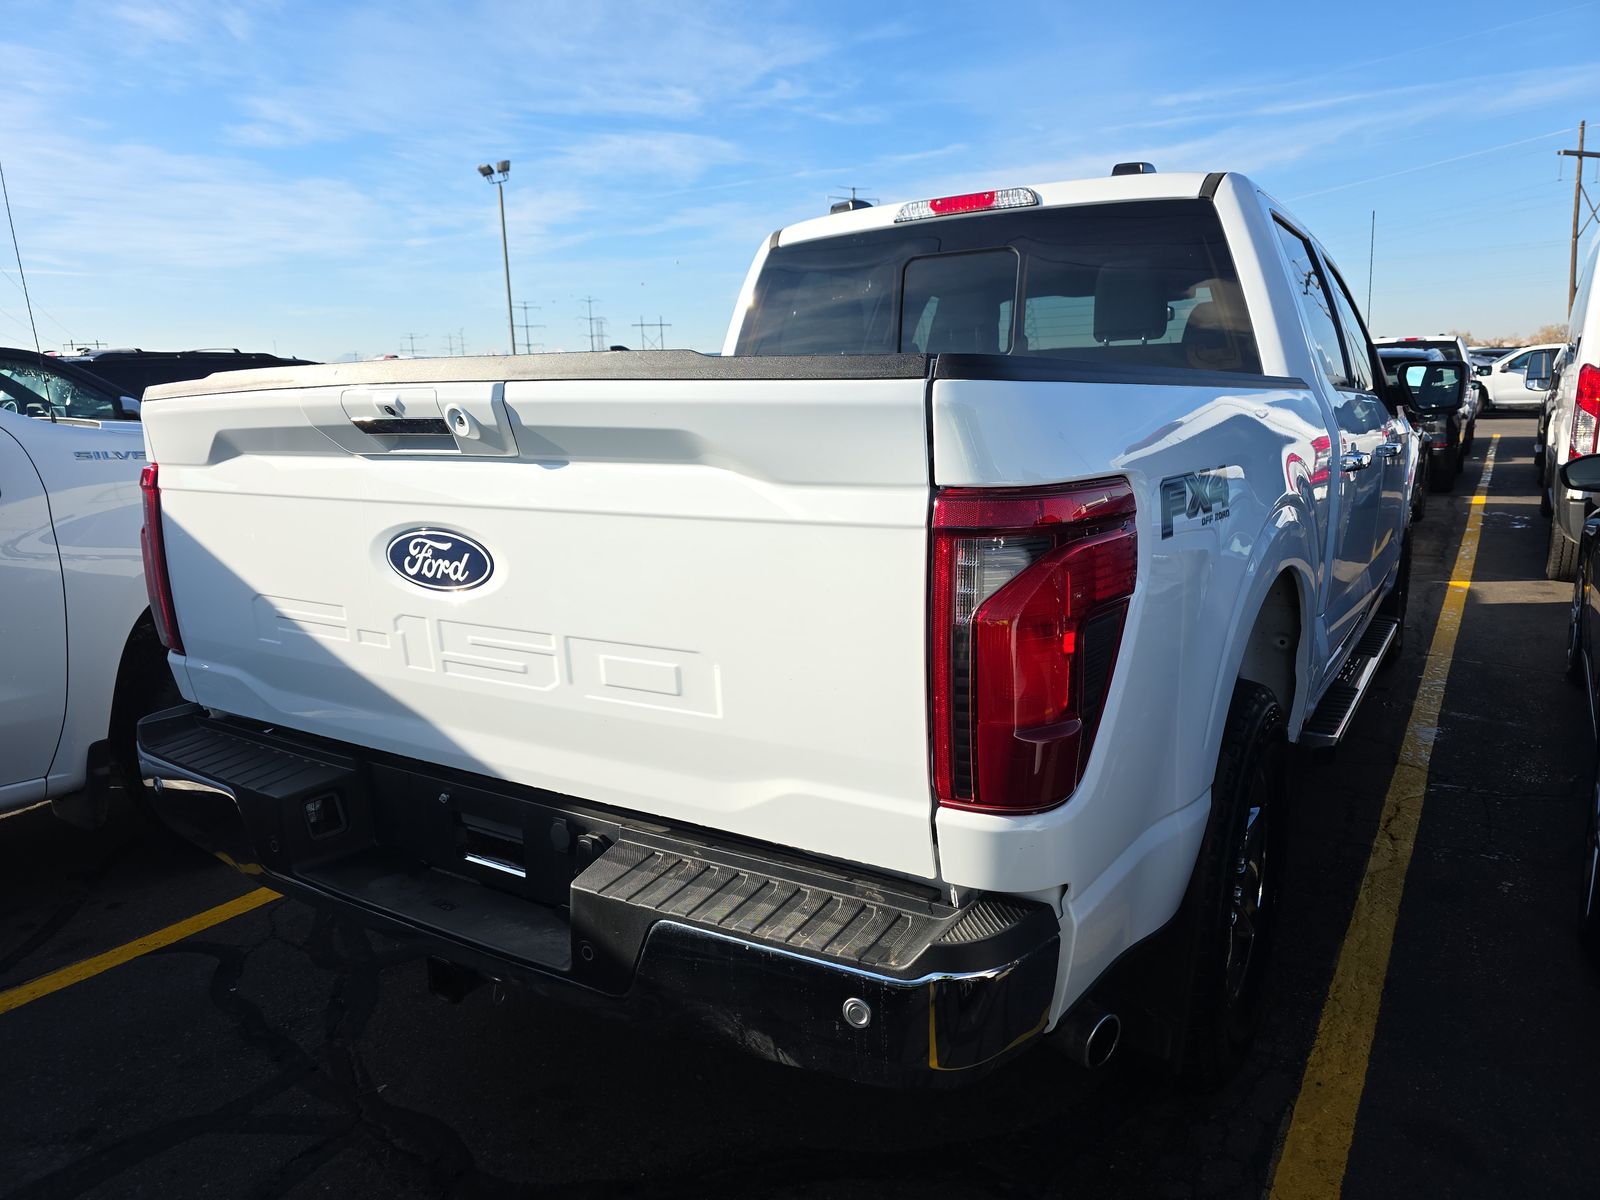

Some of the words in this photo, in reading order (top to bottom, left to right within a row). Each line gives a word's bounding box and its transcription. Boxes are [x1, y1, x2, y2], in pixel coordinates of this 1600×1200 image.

[1160, 464, 1229, 540] FX4
[1201, 516, 1214, 526] OFF
[1215, 509, 1230, 521] ROAD
[404, 538, 469, 582] Ford
[253, 593, 723, 719] F-150
